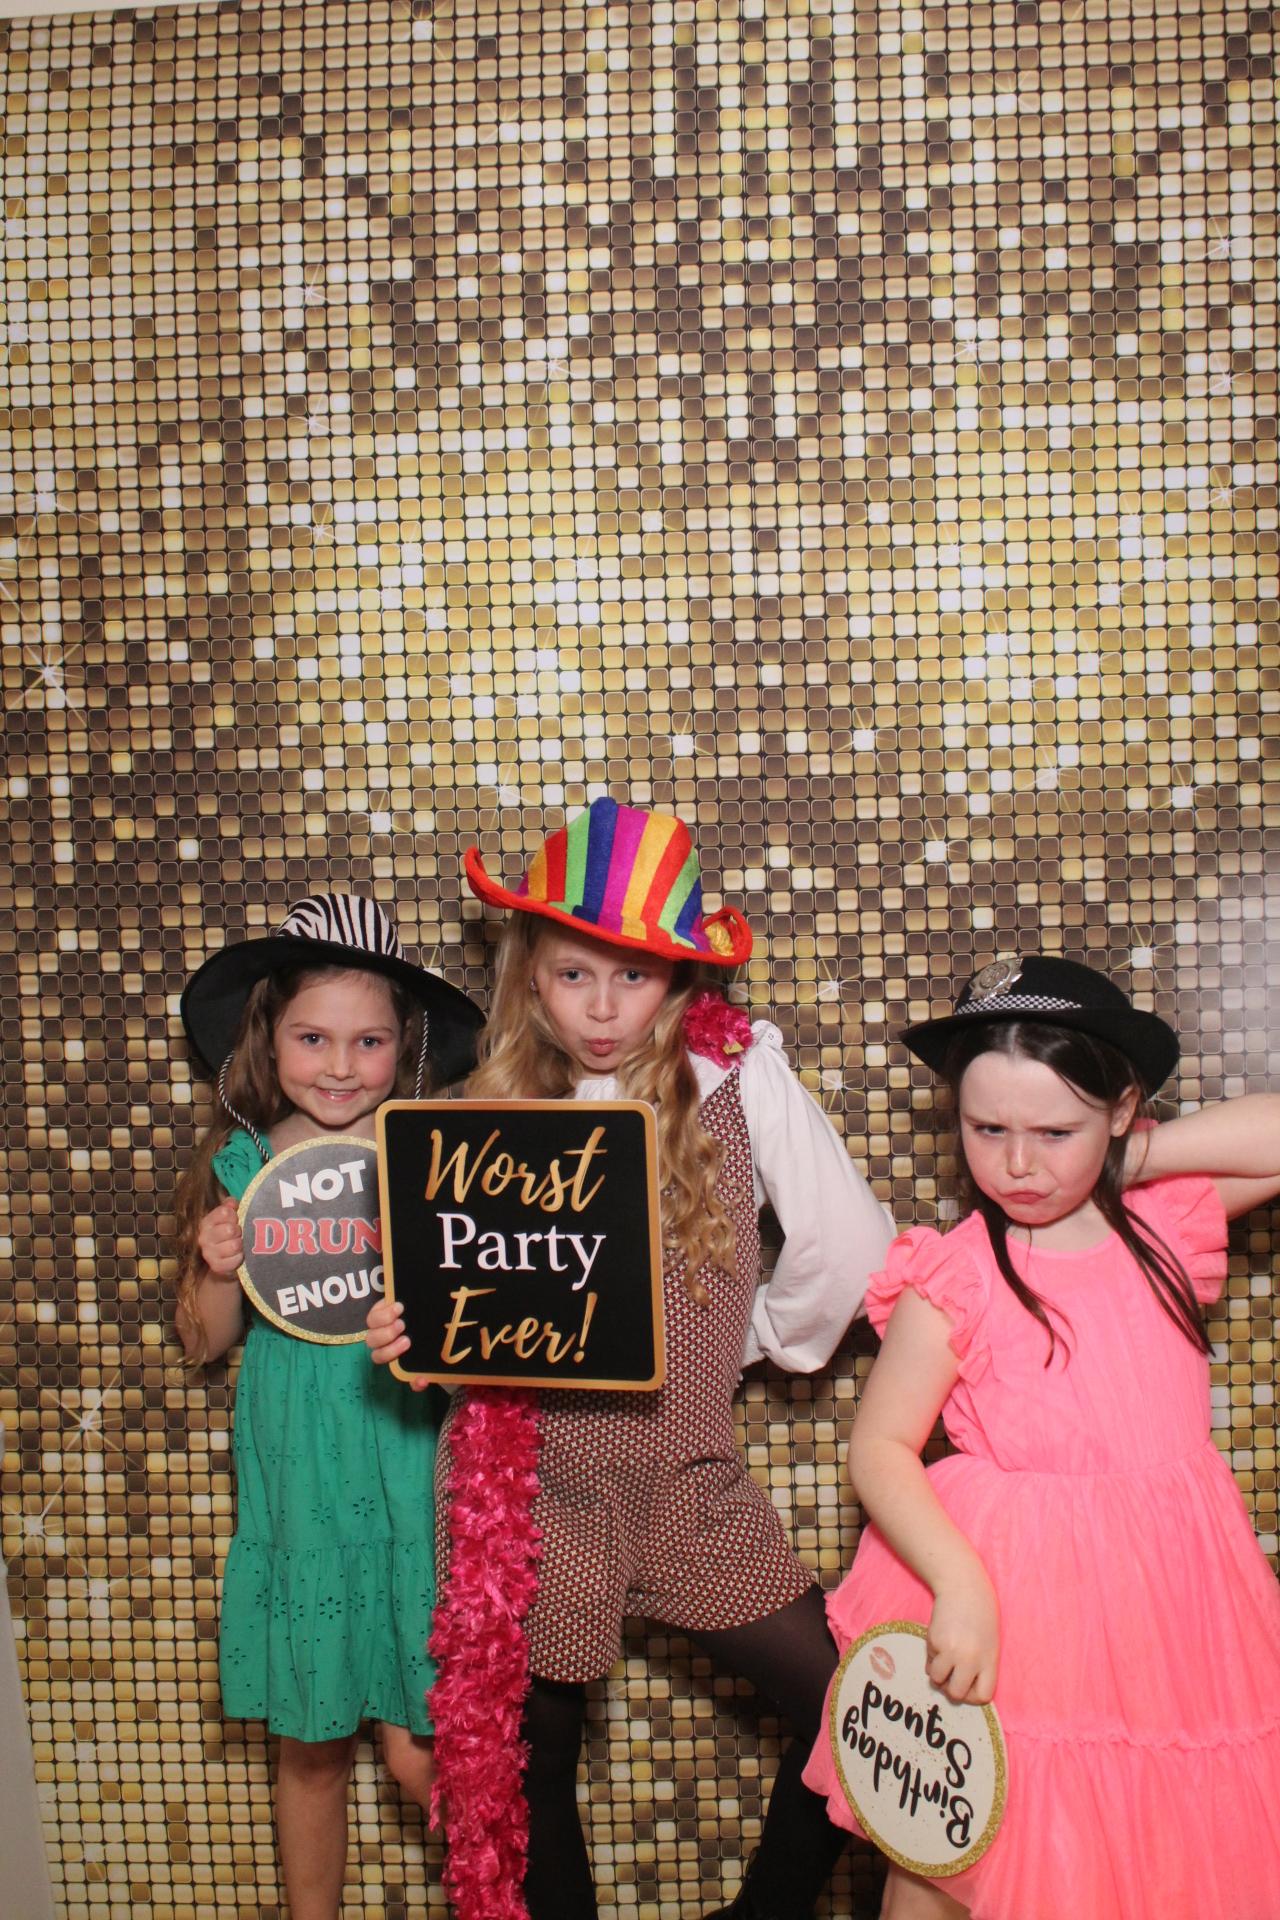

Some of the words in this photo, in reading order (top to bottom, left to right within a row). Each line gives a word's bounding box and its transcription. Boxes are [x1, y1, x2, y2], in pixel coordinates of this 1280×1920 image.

[278, 1160, 367, 1208] NOT
[425, 1126, 607, 1212] Worst
[252, 1217, 383, 1256] DRUN
[436, 1212, 606, 1291] Party
[276, 1264, 385, 1317] ENOU
[440, 1286, 598, 1365] Ever!
[861, 1681, 972, 1789] Squad
[842, 1705, 974, 1849] Birthday
